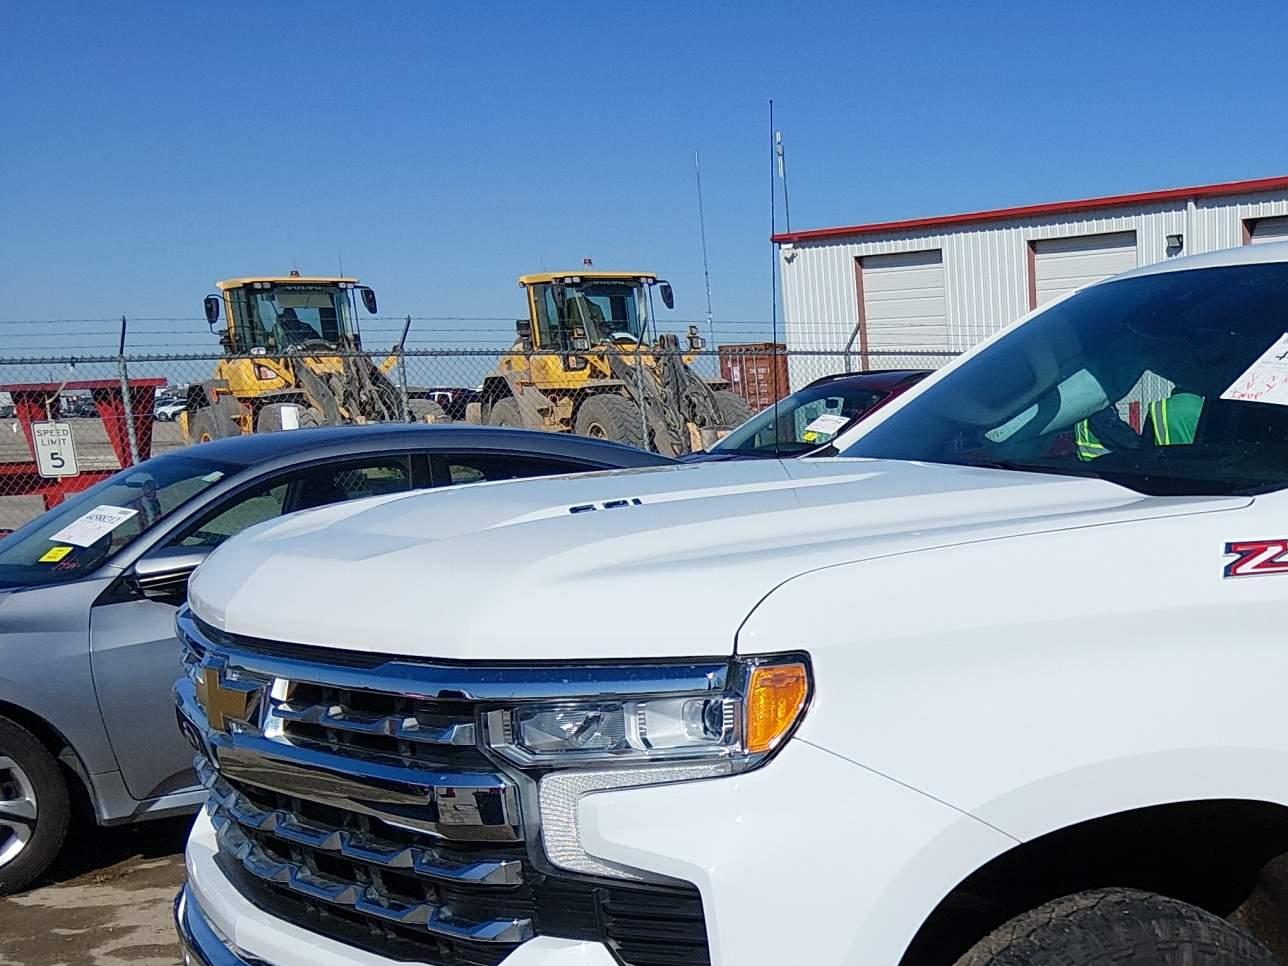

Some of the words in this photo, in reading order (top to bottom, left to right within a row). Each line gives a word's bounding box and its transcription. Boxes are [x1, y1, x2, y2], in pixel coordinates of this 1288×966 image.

[36, 429, 69, 437] SPEED
[41, 438, 67, 447] LIMIT
[50, 452, 65, 469] 5
